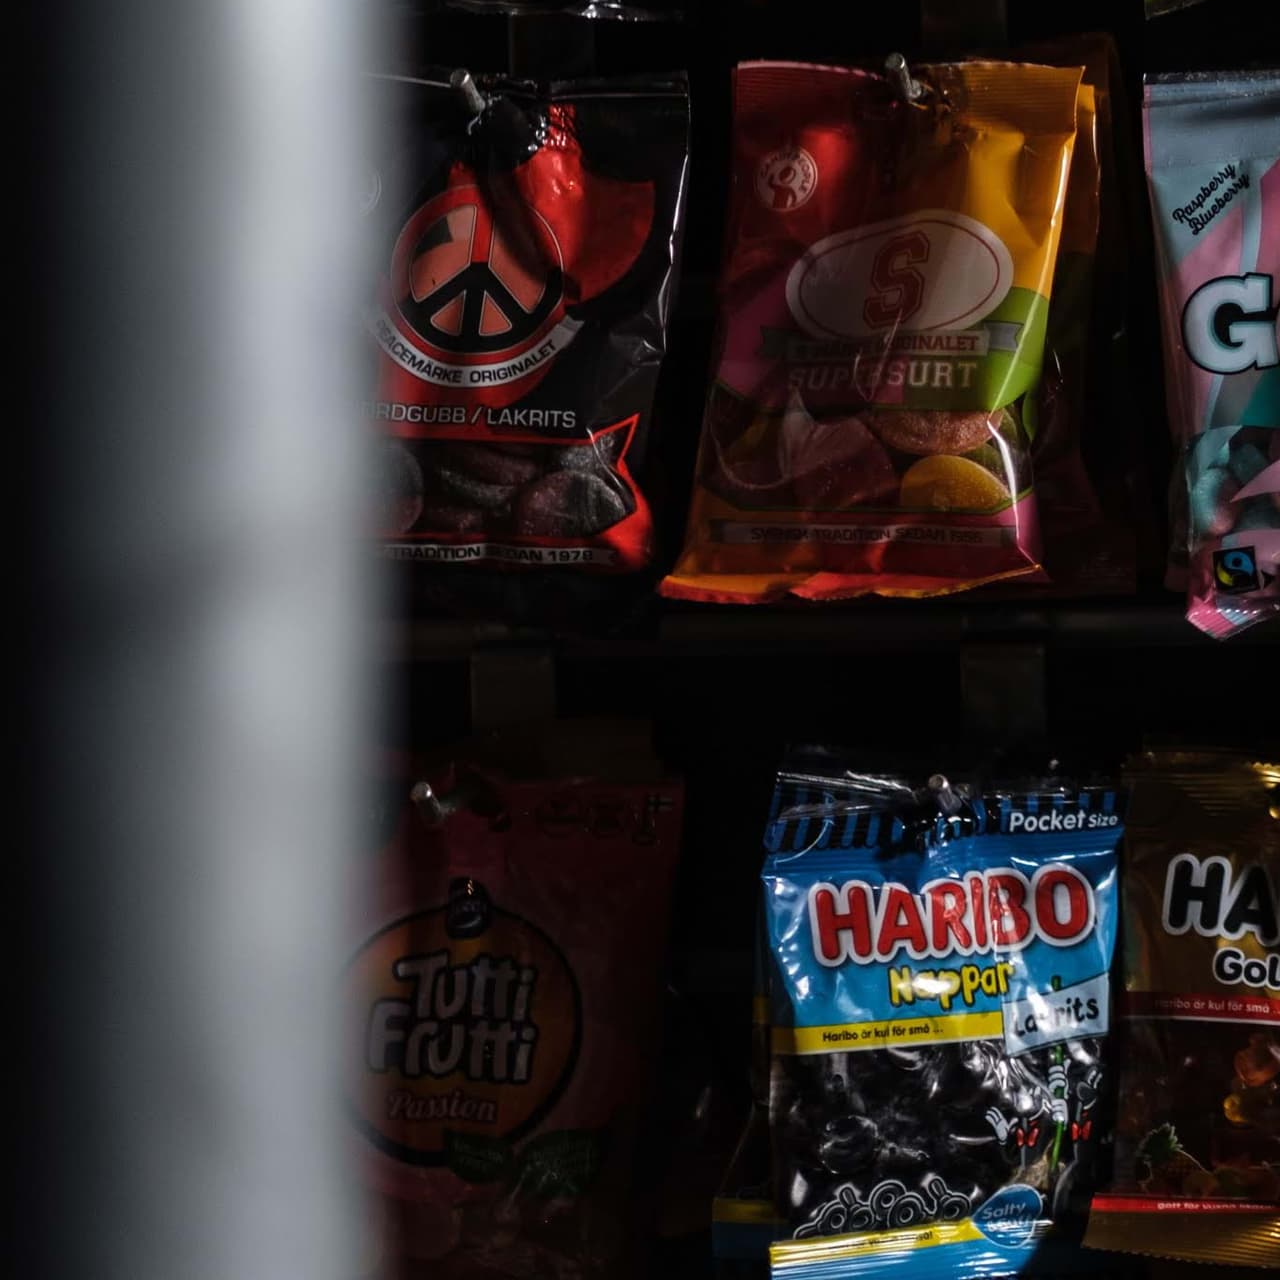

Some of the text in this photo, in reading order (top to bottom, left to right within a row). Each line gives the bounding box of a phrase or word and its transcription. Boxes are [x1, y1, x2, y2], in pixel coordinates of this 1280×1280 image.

[1172, 162, 1237, 228] Raspberry
[1191, 172, 1251, 236] Blueberry
[863, 231, 929, 329] S
[470, 339, 557, 384] ORIGINALET
[487, 407, 577, 429] LAKRITS
[550, 549, 593, 562] 1978
[1009, 809, 1120, 834] Pocket Size
[812, 866, 1093, 963] HARIBO
[397, 952, 537, 1022] Tutti
[370, 1000, 538, 1083] Frutti
[822, 1022, 930, 1043] Haribo små
[387, 1088, 498, 1122] Passion
